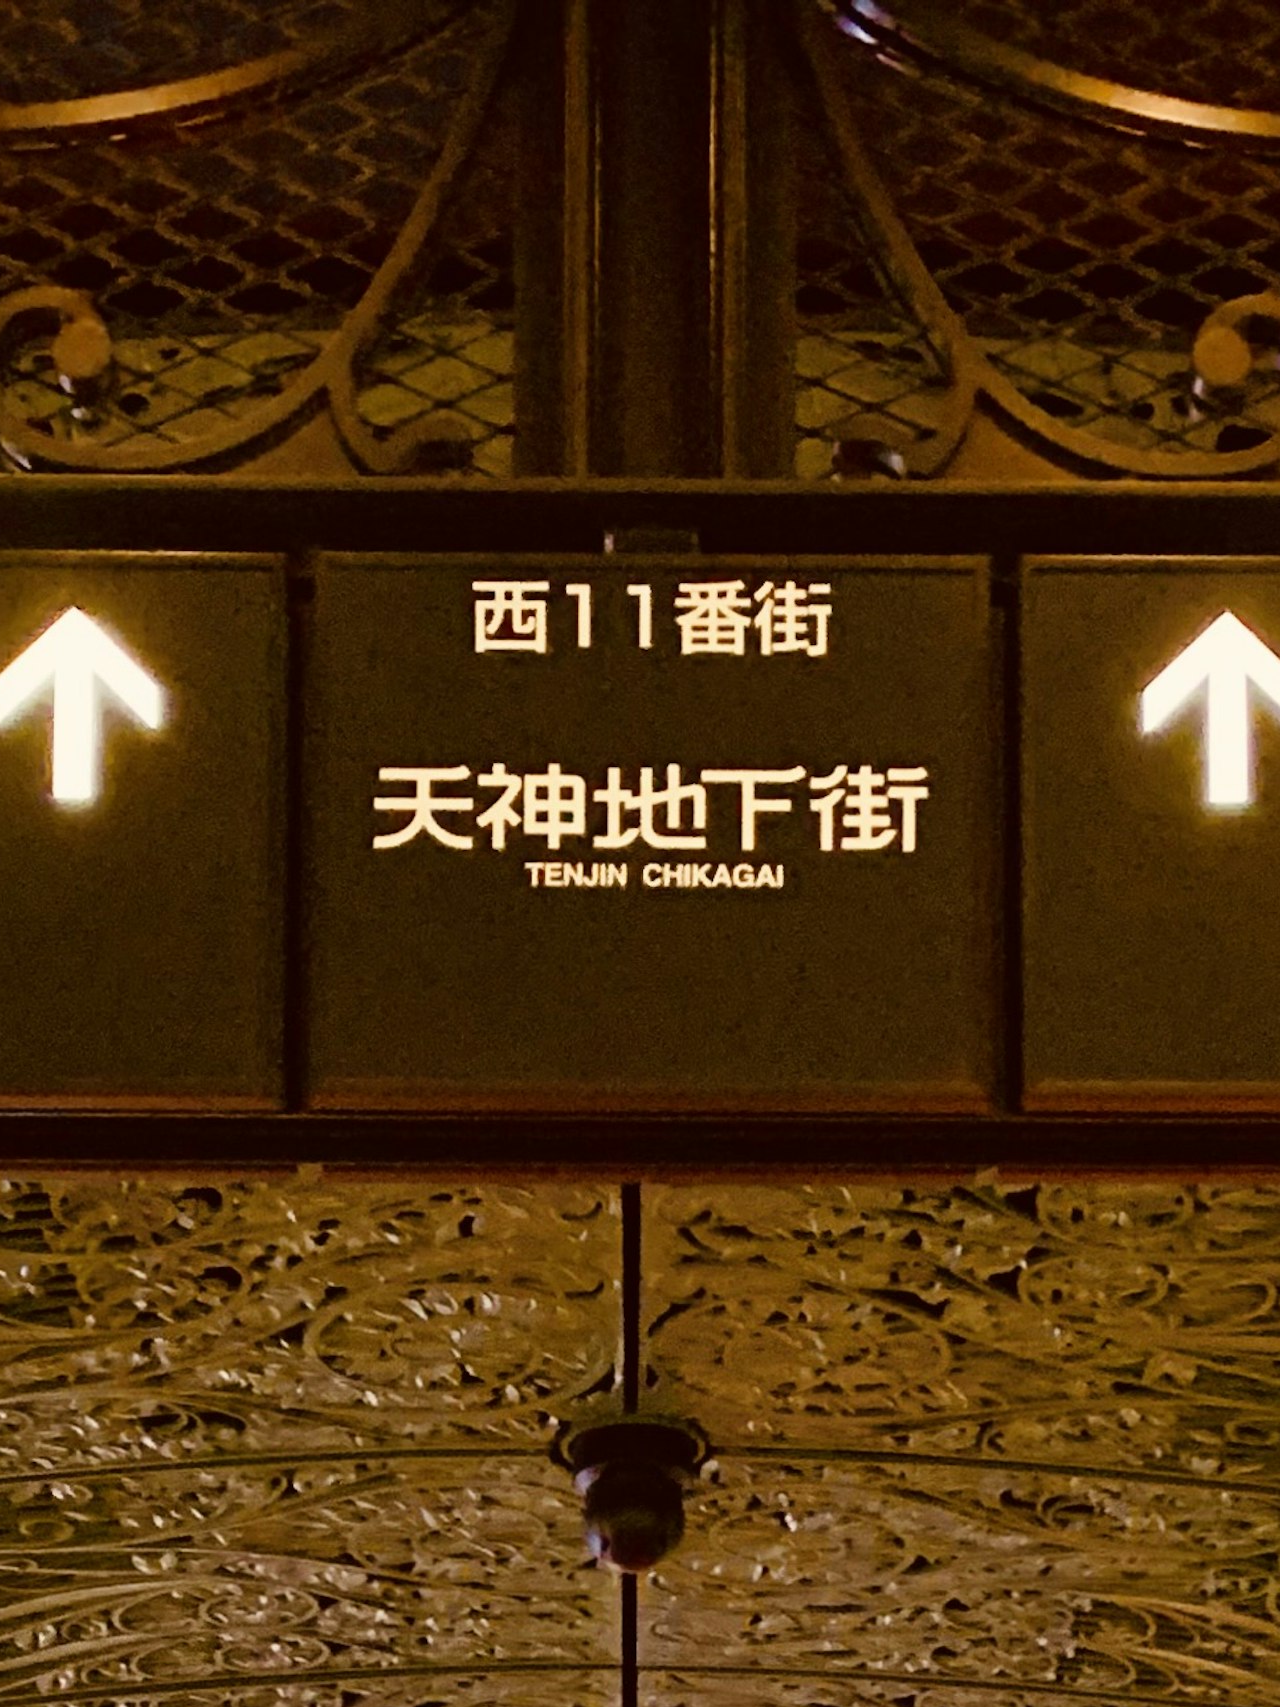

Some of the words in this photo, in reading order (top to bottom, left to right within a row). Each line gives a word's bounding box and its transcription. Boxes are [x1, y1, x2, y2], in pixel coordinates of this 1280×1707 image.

[472, 580, 832, 657] 西11番街
[373, 763, 930, 853] 天神地下街
[524, 862, 628, 887] TENJIN
[642, 863, 784, 888] CHIKAGAI
